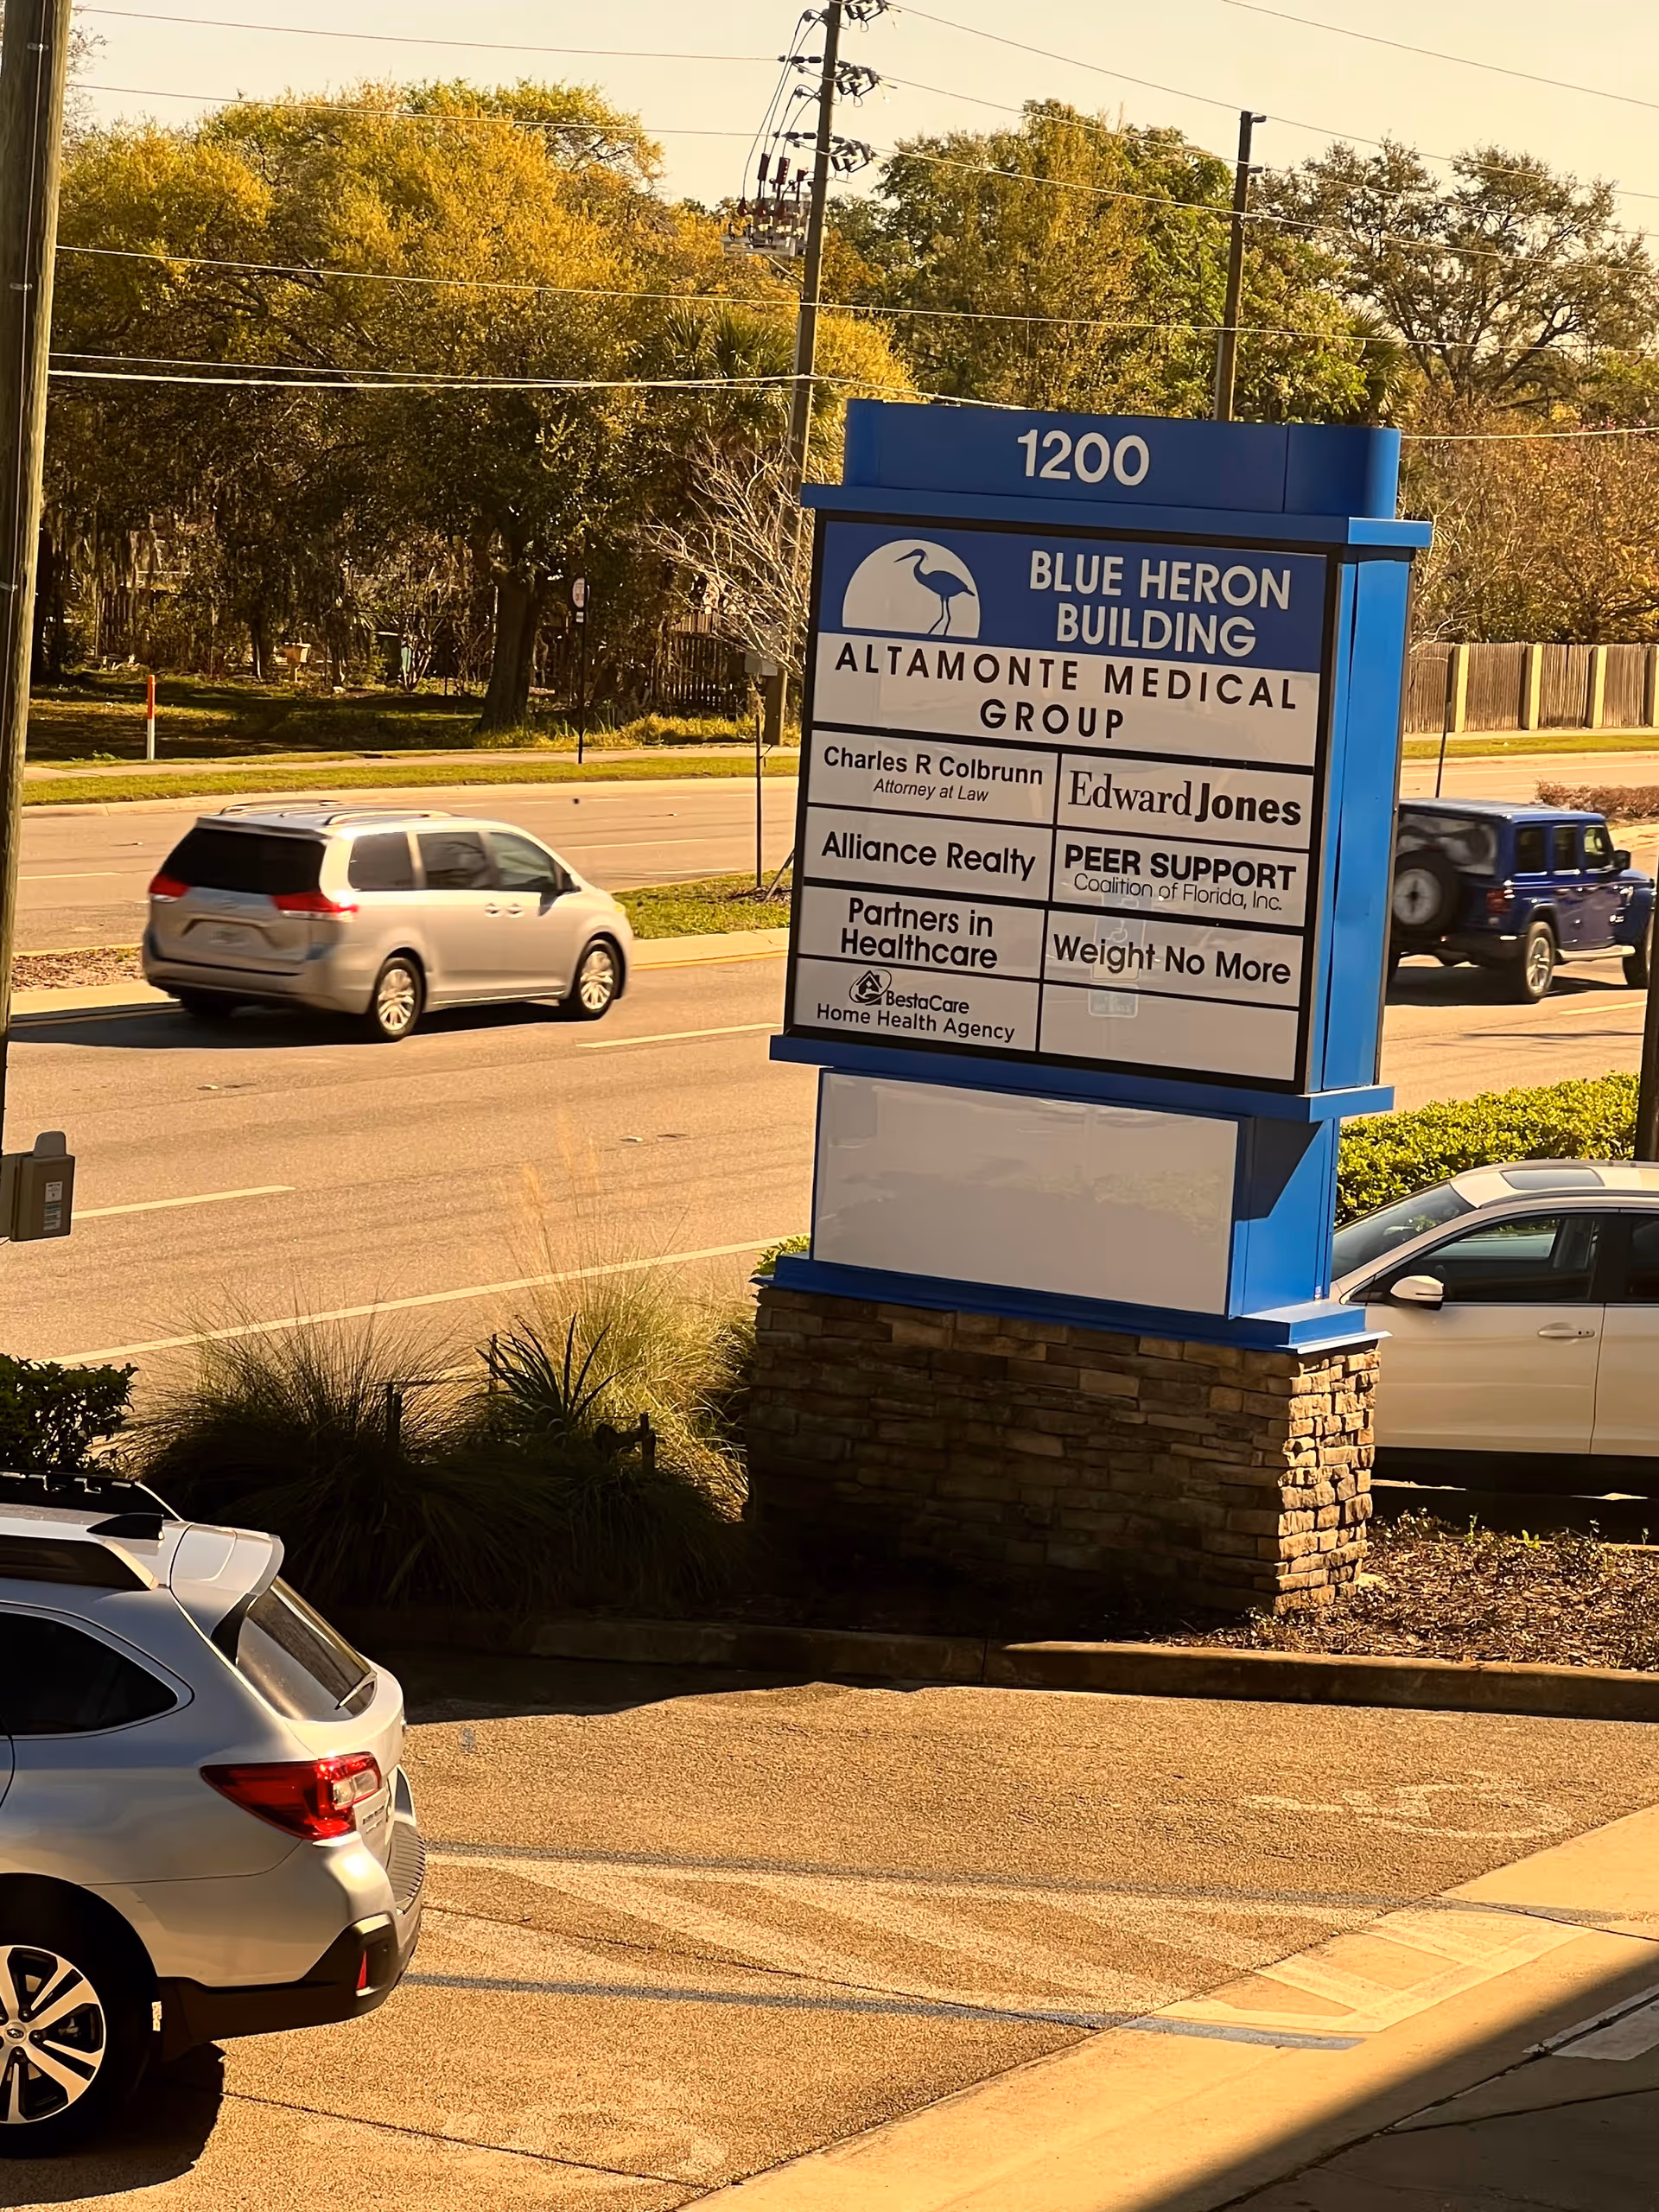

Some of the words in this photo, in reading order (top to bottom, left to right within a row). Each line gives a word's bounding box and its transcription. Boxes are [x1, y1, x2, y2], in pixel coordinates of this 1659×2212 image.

[1018, 429, 1149, 486] 1200
[1030, 551, 1123, 595] BLUE
[1141, 559, 1290, 609] HERON
[1057, 603, 1255, 657] BUILDING
[836, 642, 1078, 690] ALTAMONTE
[1105, 664, 1296, 709] MEDICAL
[981, 699, 1123, 738] GROUP
[824, 747, 906, 772] Charles
[916, 754, 931, 774] R
[940, 756, 1042, 785] Colbrunn
[874, 779, 936, 800] Attorney
[939, 785, 953, 798] at
[958, 785, 988, 801] Law
[822, 831, 936, 866] Alliance
[947, 842, 1035, 881] Realty
[1065, 844, 1141, 876] PEER
[1150, 853, 1296, 890] SUPPORT
[1074, 873, 1153, 897] Coalition
[1159, 882, 1178, 899] of
[1184, 881, 1247, 907] Florida,
[1253, 891, 1281, 910] Inc.
[849, 898, 958, 935] Partners
[969, 910, 992, 937] in
[841, 929, 998, 969] Healthcare
[1054, 934, 1155, 973] Weight
[1166, 946, 1205, 975] No
[1216, 951, 1290, 984] More
[886, 989, 969, 1014] BestaCare
[817, 1003, 870, 1024] Home
[878, 1010, 936, 1031] Health
[944, 1018, 1014, 1043] Agency
